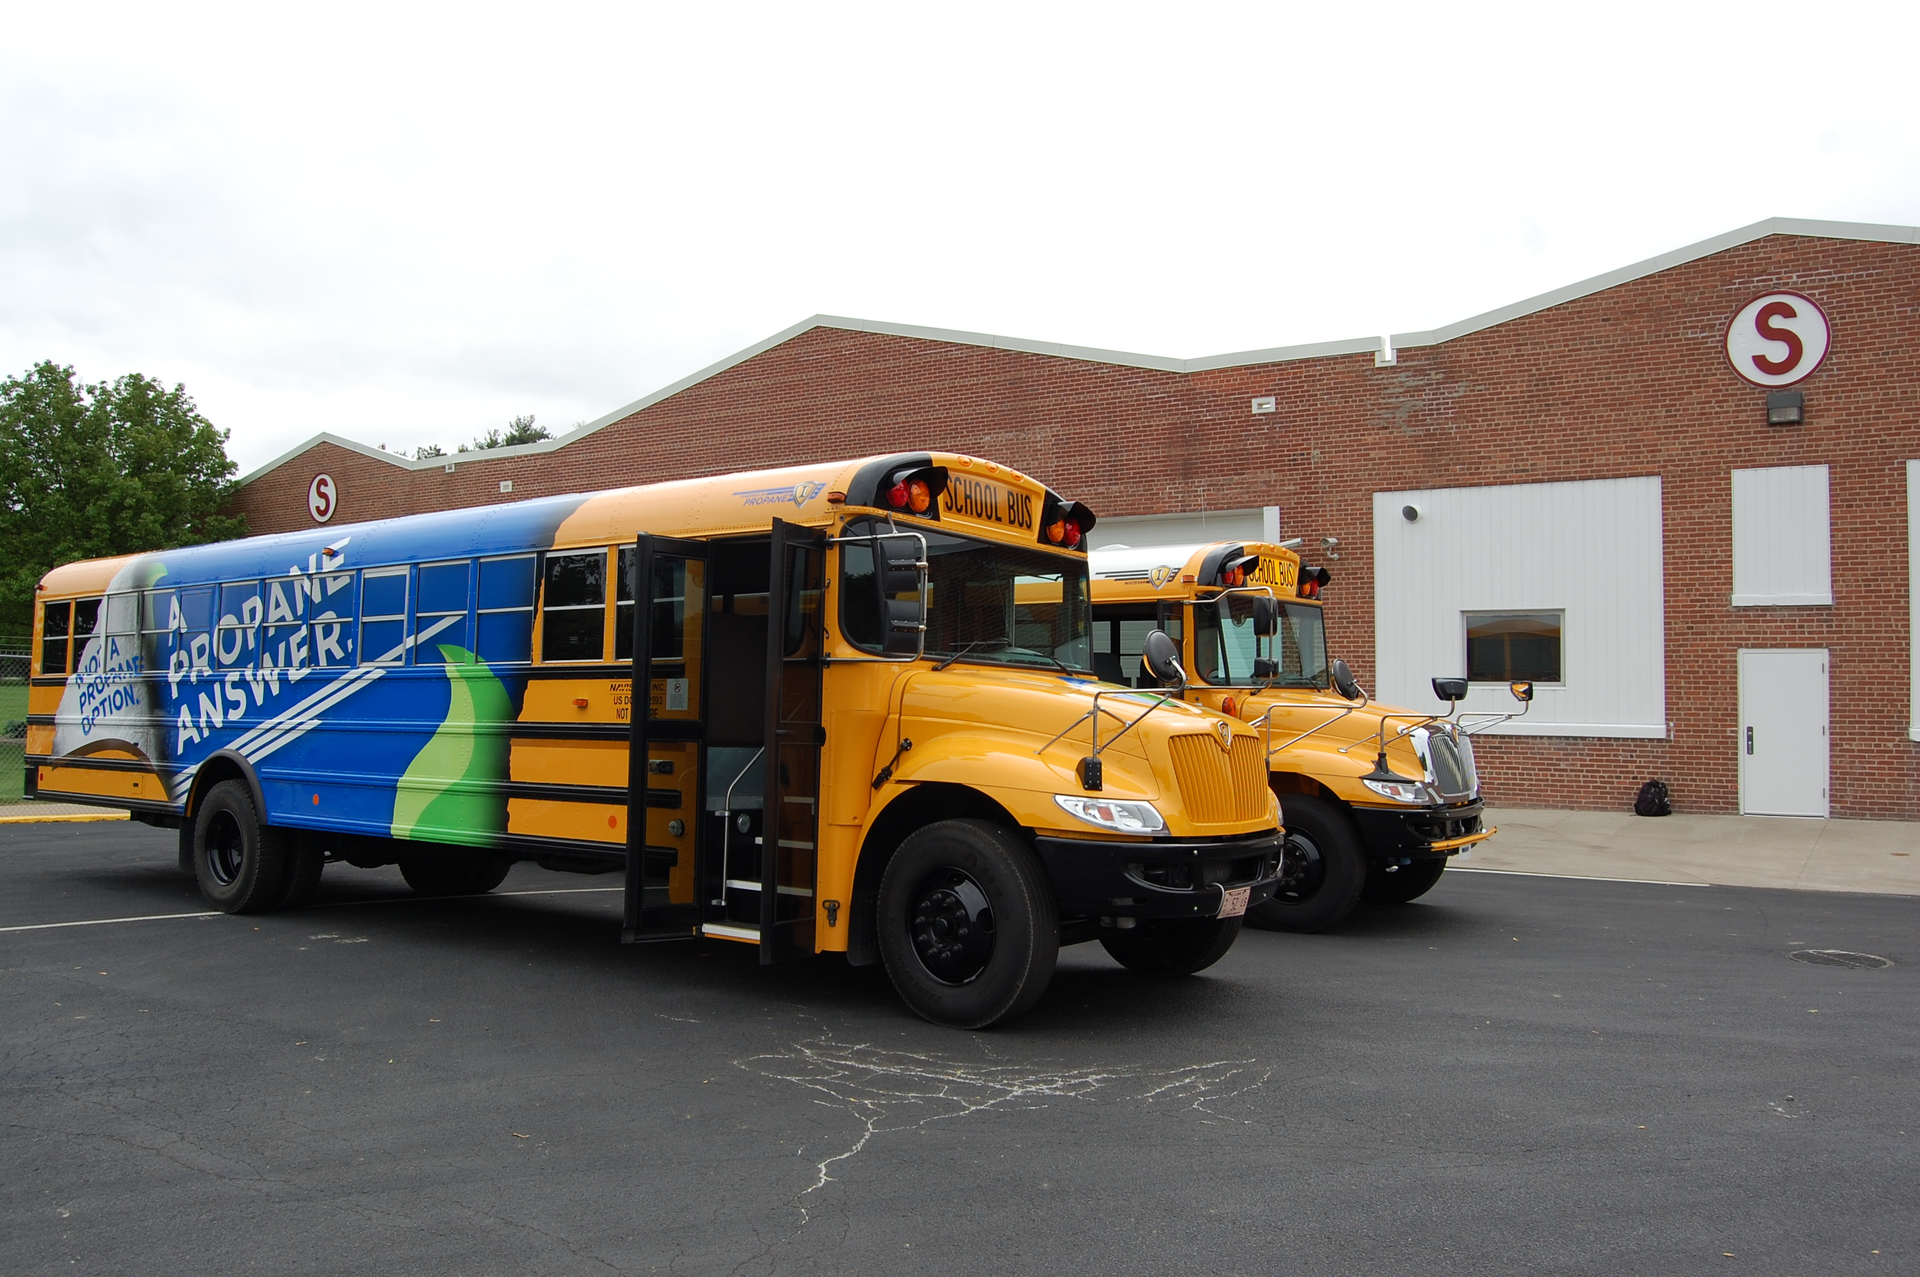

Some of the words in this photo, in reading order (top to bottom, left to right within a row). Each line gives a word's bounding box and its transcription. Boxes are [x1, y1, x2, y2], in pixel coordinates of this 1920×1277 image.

[1751, 301, 1803, 376] S
[315, 477, 330, 517] S
[743, 493, 788, 506] PROPANE
[945, 475, 1002, 522] SCHOOL
[1007, 490, 1032, 529] BUS
[1279, 561, 1294, 588] BUS
[168, 536, 352, 700] PROPANE
[168, 594, 188, 648] A
[110, 637, 120, 660] A
[177, 610, 353, 756] ANSWER.
[613, 695, 623, 705] US
[81, 684, 140, 736] OPTION.
[616, 707, 629, 720] NOT
